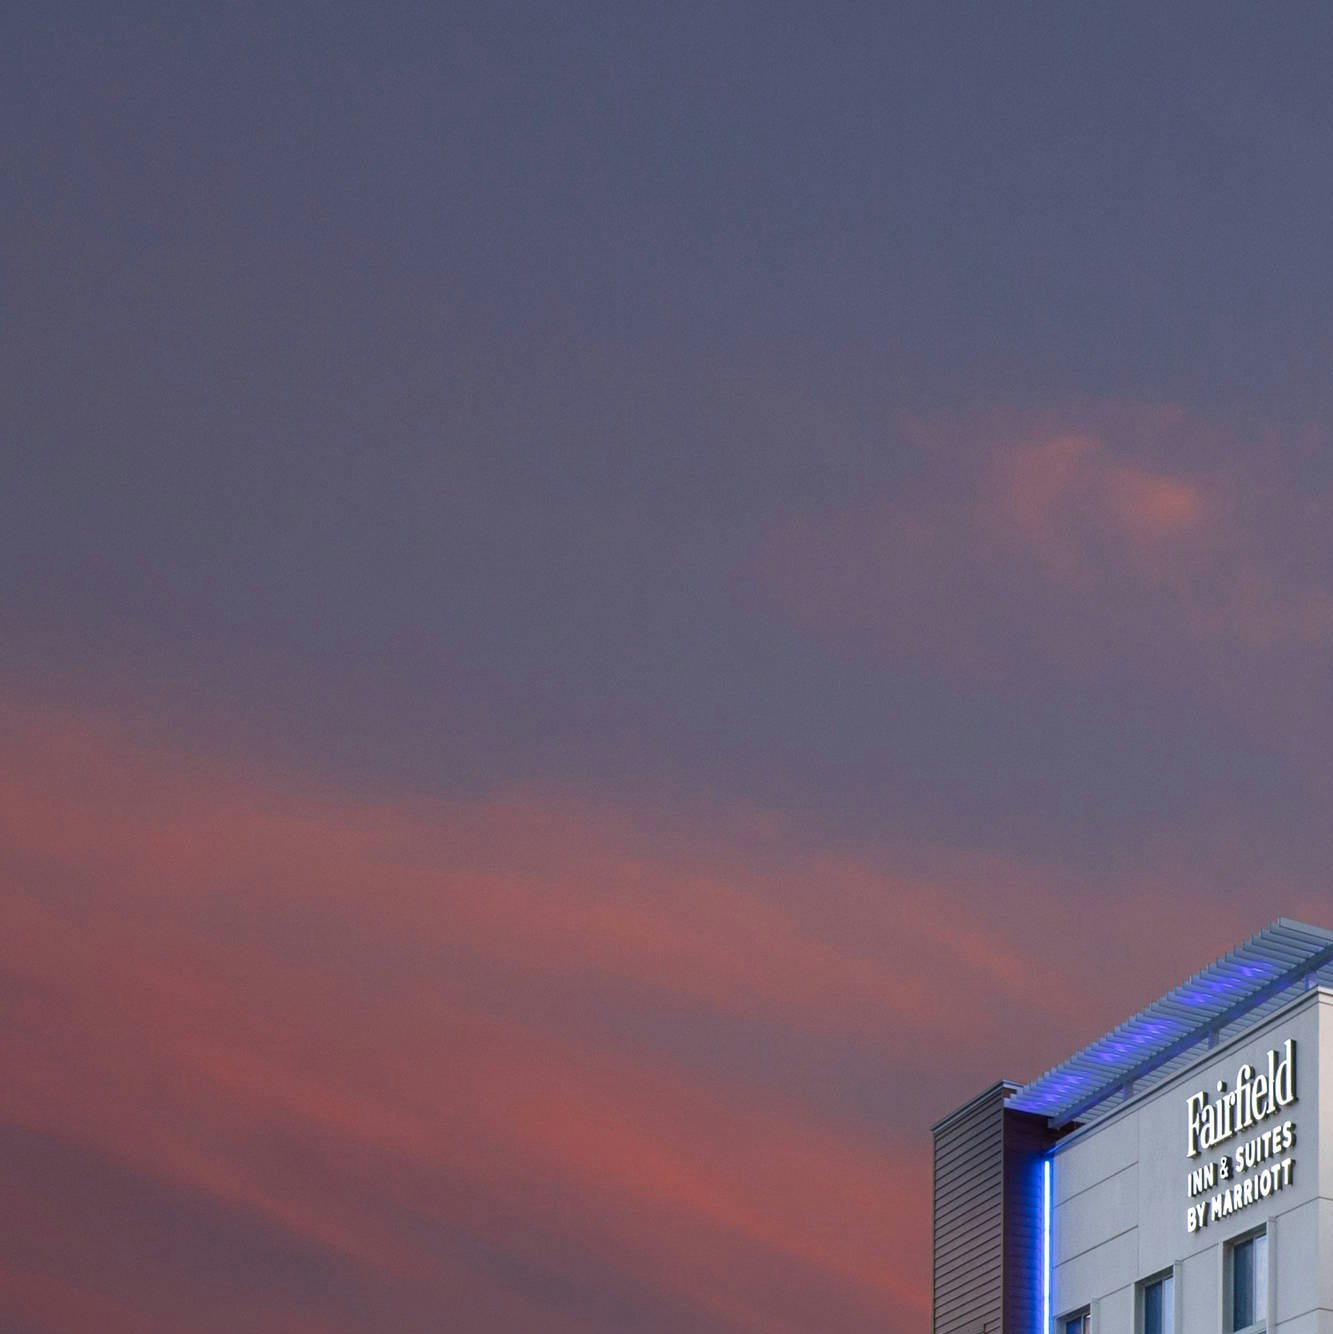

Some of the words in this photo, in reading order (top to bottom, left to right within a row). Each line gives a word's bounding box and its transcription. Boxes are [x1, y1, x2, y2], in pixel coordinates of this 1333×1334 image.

[1186, 1038, 1296, 1158] Fairfield
[1188, 1162, 1216, 1198] INN
[1219, 1156, 1231, 1179] &
[1235, 1121, 1294, 1173] SUITES
[1188, 1202, 1207, 1233] BY
[1211, 1158, 1293, 1222] MARRIOTT
